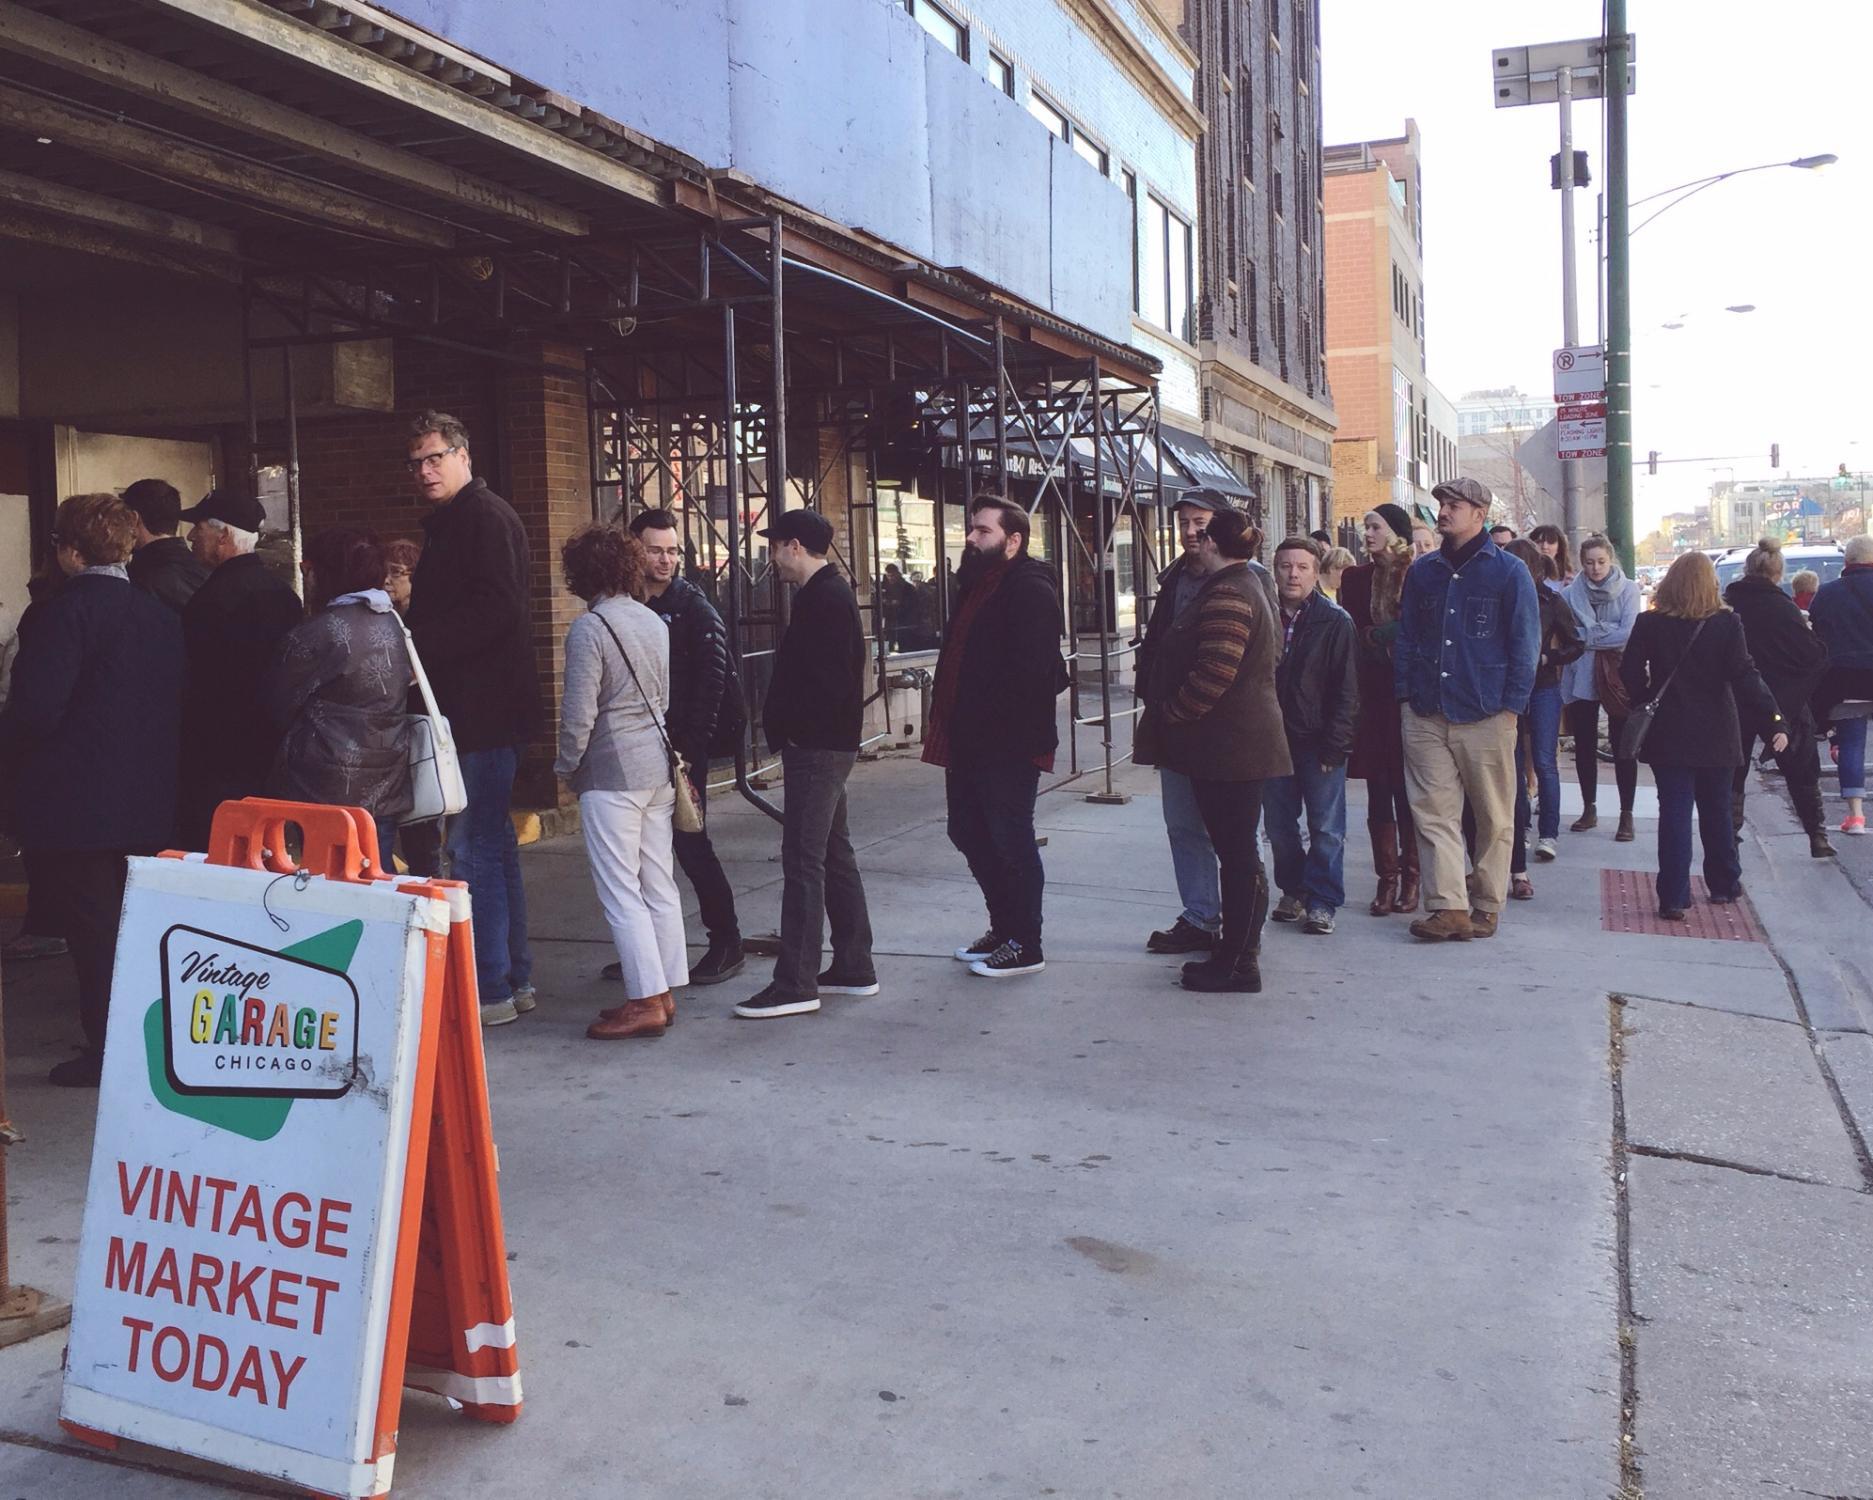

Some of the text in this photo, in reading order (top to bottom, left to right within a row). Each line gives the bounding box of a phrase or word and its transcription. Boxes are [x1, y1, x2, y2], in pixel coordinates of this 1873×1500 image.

[1580, 392, 1601, 400] ZONE
[1582, 449, 1603, 457] ZONE
[1772, 501, 1800, 512] CAR
[181, 950, 271, 1000] Vintage
[190, 988, 340, 1051] GARAGE
[215, 1055, 312, 1071] CHICAGO
[117, 1160, 353, 1258] VINTAGE
[104, 1236, 340, 1335] MARKET
[121, 1316, 308, 1410] TODAY
